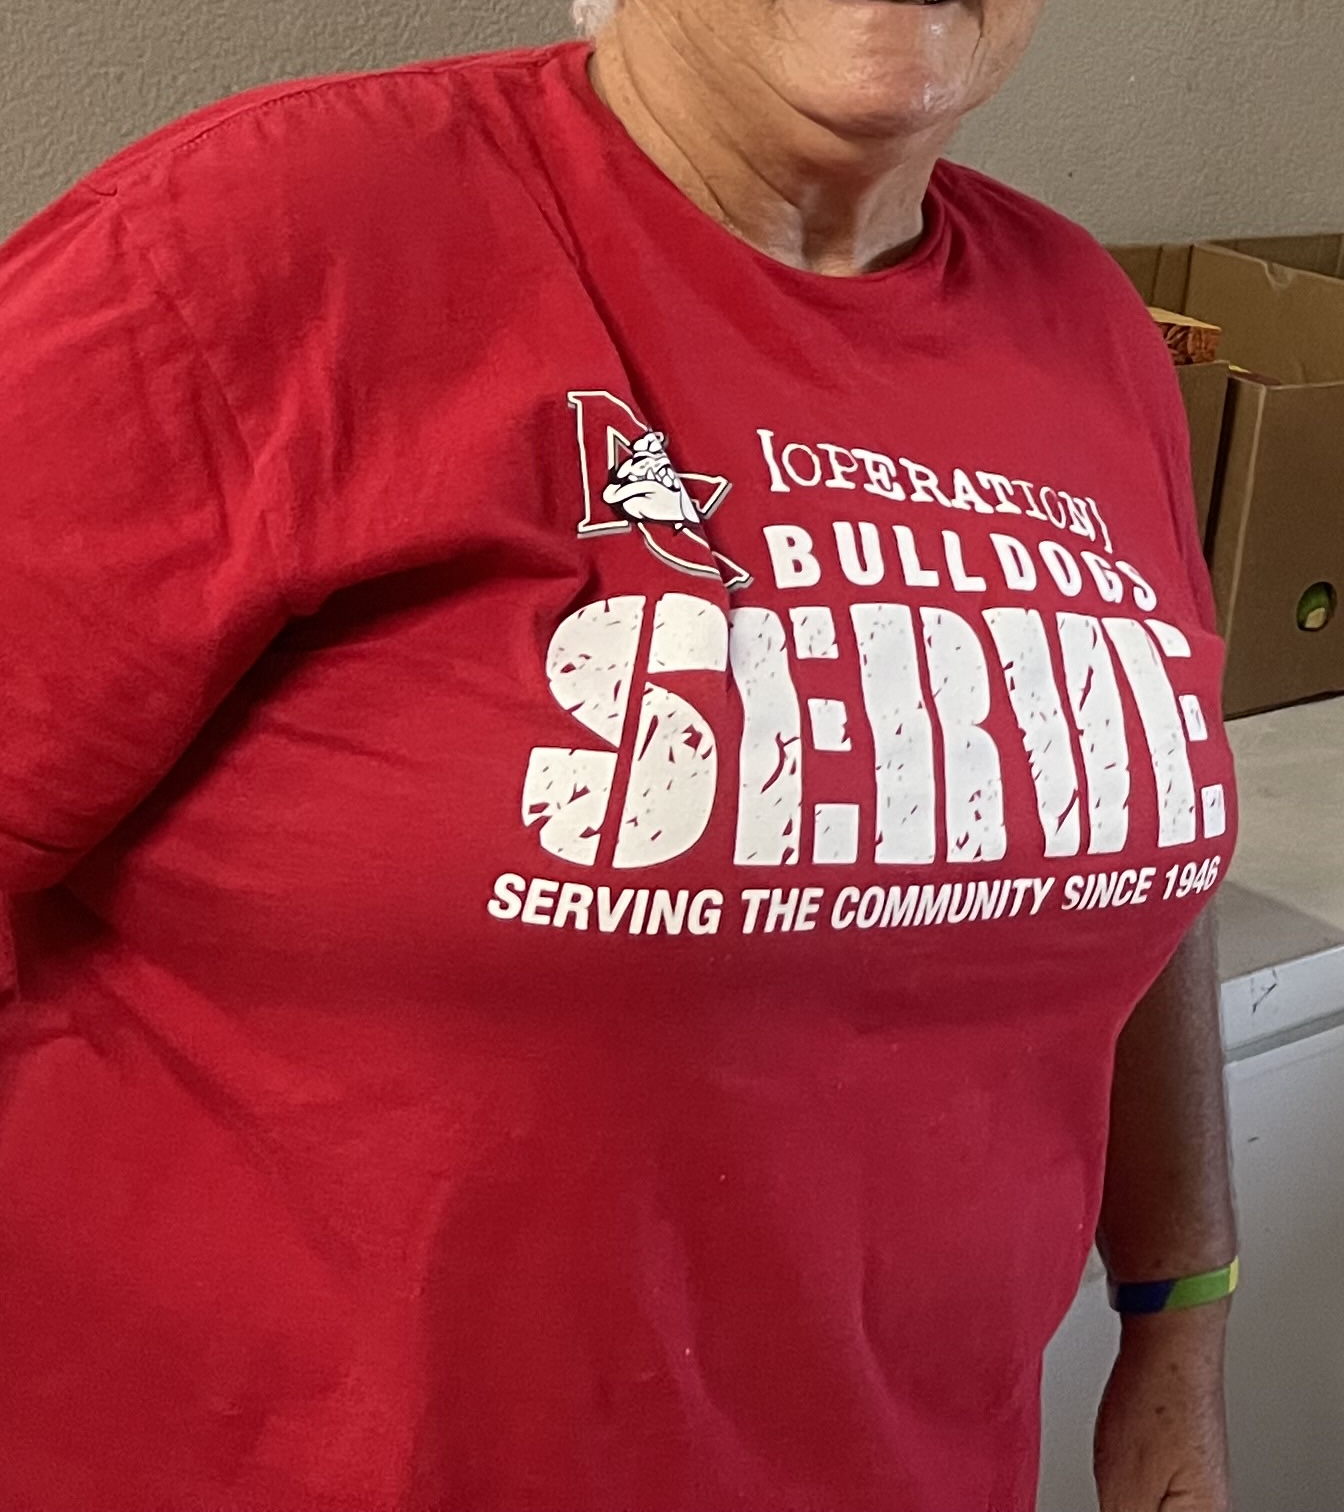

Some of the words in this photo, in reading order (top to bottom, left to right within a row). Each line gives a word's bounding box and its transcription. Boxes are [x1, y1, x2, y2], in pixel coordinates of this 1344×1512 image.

[764, 522, 1157, 611] BULLDOGS
[522, 592, 1224, 869] SERVE
[488, 873, 723, 936] SERVING
[741, 888, 825, 935] THE
[831, 877, 1052, 929] COMMUNITY
[1062, 867, 1152, 912] SINCE
[1163, 856, 1221, 898] 1946
